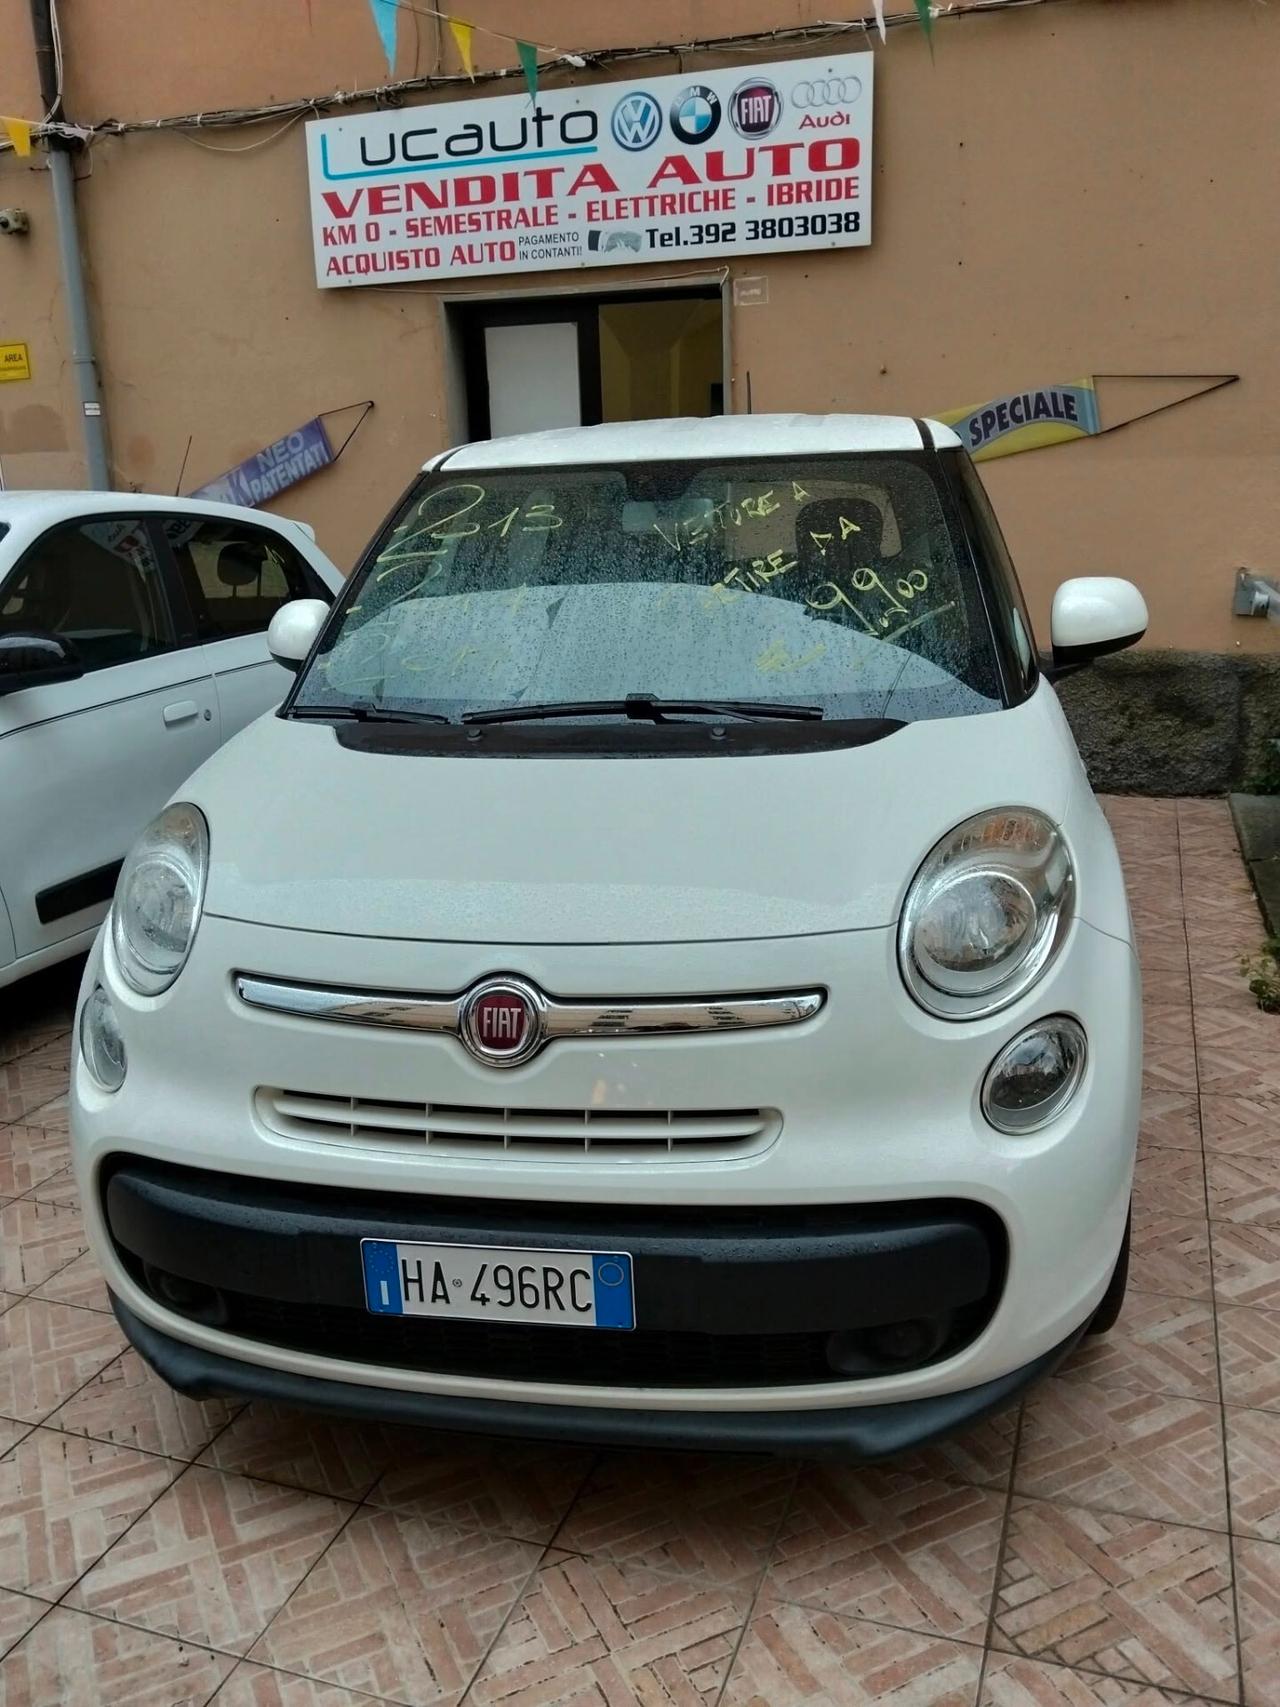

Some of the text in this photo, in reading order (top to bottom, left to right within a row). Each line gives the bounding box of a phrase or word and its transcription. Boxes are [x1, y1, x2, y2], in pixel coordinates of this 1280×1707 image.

[741, 96, 771, 125] FIAT
[798, 111, 851, 130] Audi
[321, 137, 860, 218] VENDITA AUTO
[323, 225, 356, 246] KM
[406, 204, 558, 238] SEMESTRALE
[587, 188, 736, 222] ELETTRICHE
[767, 176, 859, 206] IBRIDE
[645, 211, 860, 249] Tel.392 3803038
[518, 231, 580, 246] PAGAMENTO
[519, 251, 528, 261] IN
[327, 240, 516, 277] ACQUISTO AUTO
[969, 392, 1078, 446] SPECIALE
[256, 431, 304, 473] NEO
[249, 441, 329, 502] PATENTATI
[483, 1007, 521, 1039] FIAT
[402, 1259, 450, 1304] HA
[470, 1263, 592, 1312] 496RC
